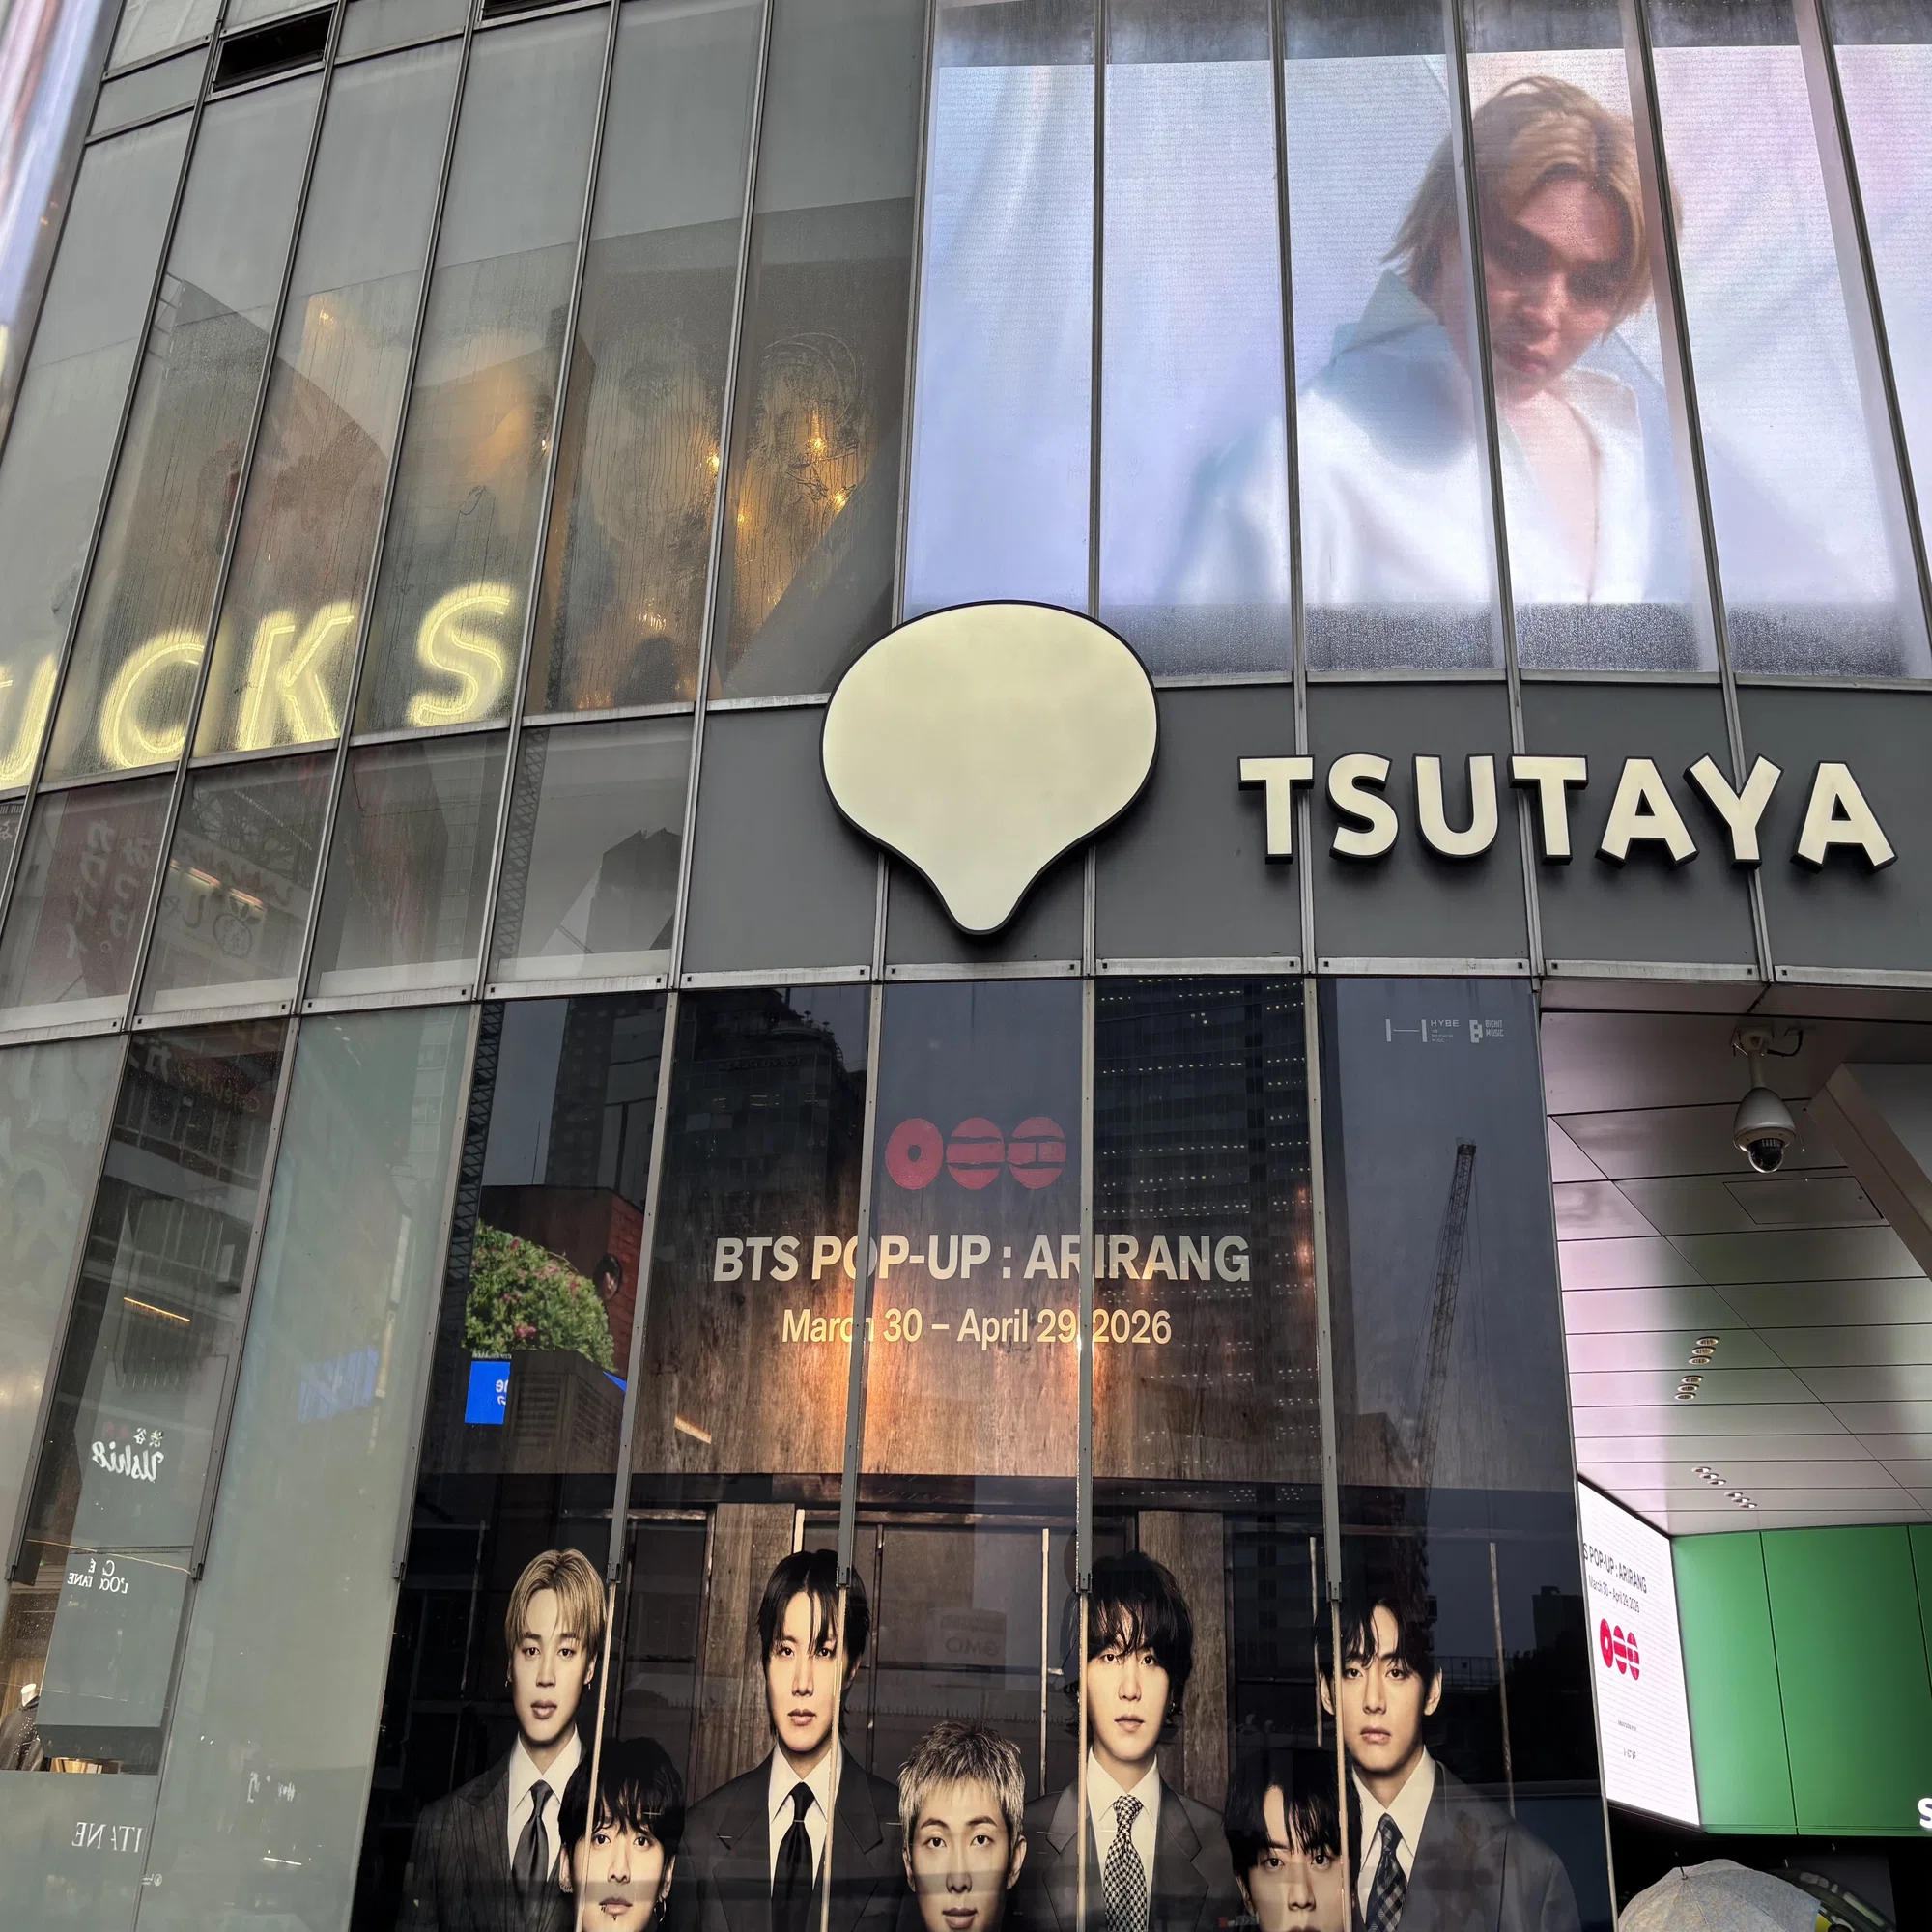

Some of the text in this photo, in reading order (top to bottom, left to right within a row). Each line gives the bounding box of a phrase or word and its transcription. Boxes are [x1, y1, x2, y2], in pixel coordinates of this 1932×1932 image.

[1239, 753, 1897, 872] TSUTAYA
[1430, 1019, 1460, 1028] HYBE
[1485, 1029, 1504, 1037] MUSIC
[713, 1235, 801, 1283] BTS
[811, 1234, 991, 1281] POP-UP
[1023, 1234, 1250, 1283] ARIRANG
[883, 1307, 923, 1344] 30
[956, 1307, 1029, 1351] April
[1093, 1308, 1173, 1345] 2026
[1589, 1545, 1614, 1575] POP-UP
[1618, 1562, 1647, 1594] ARIRANG
